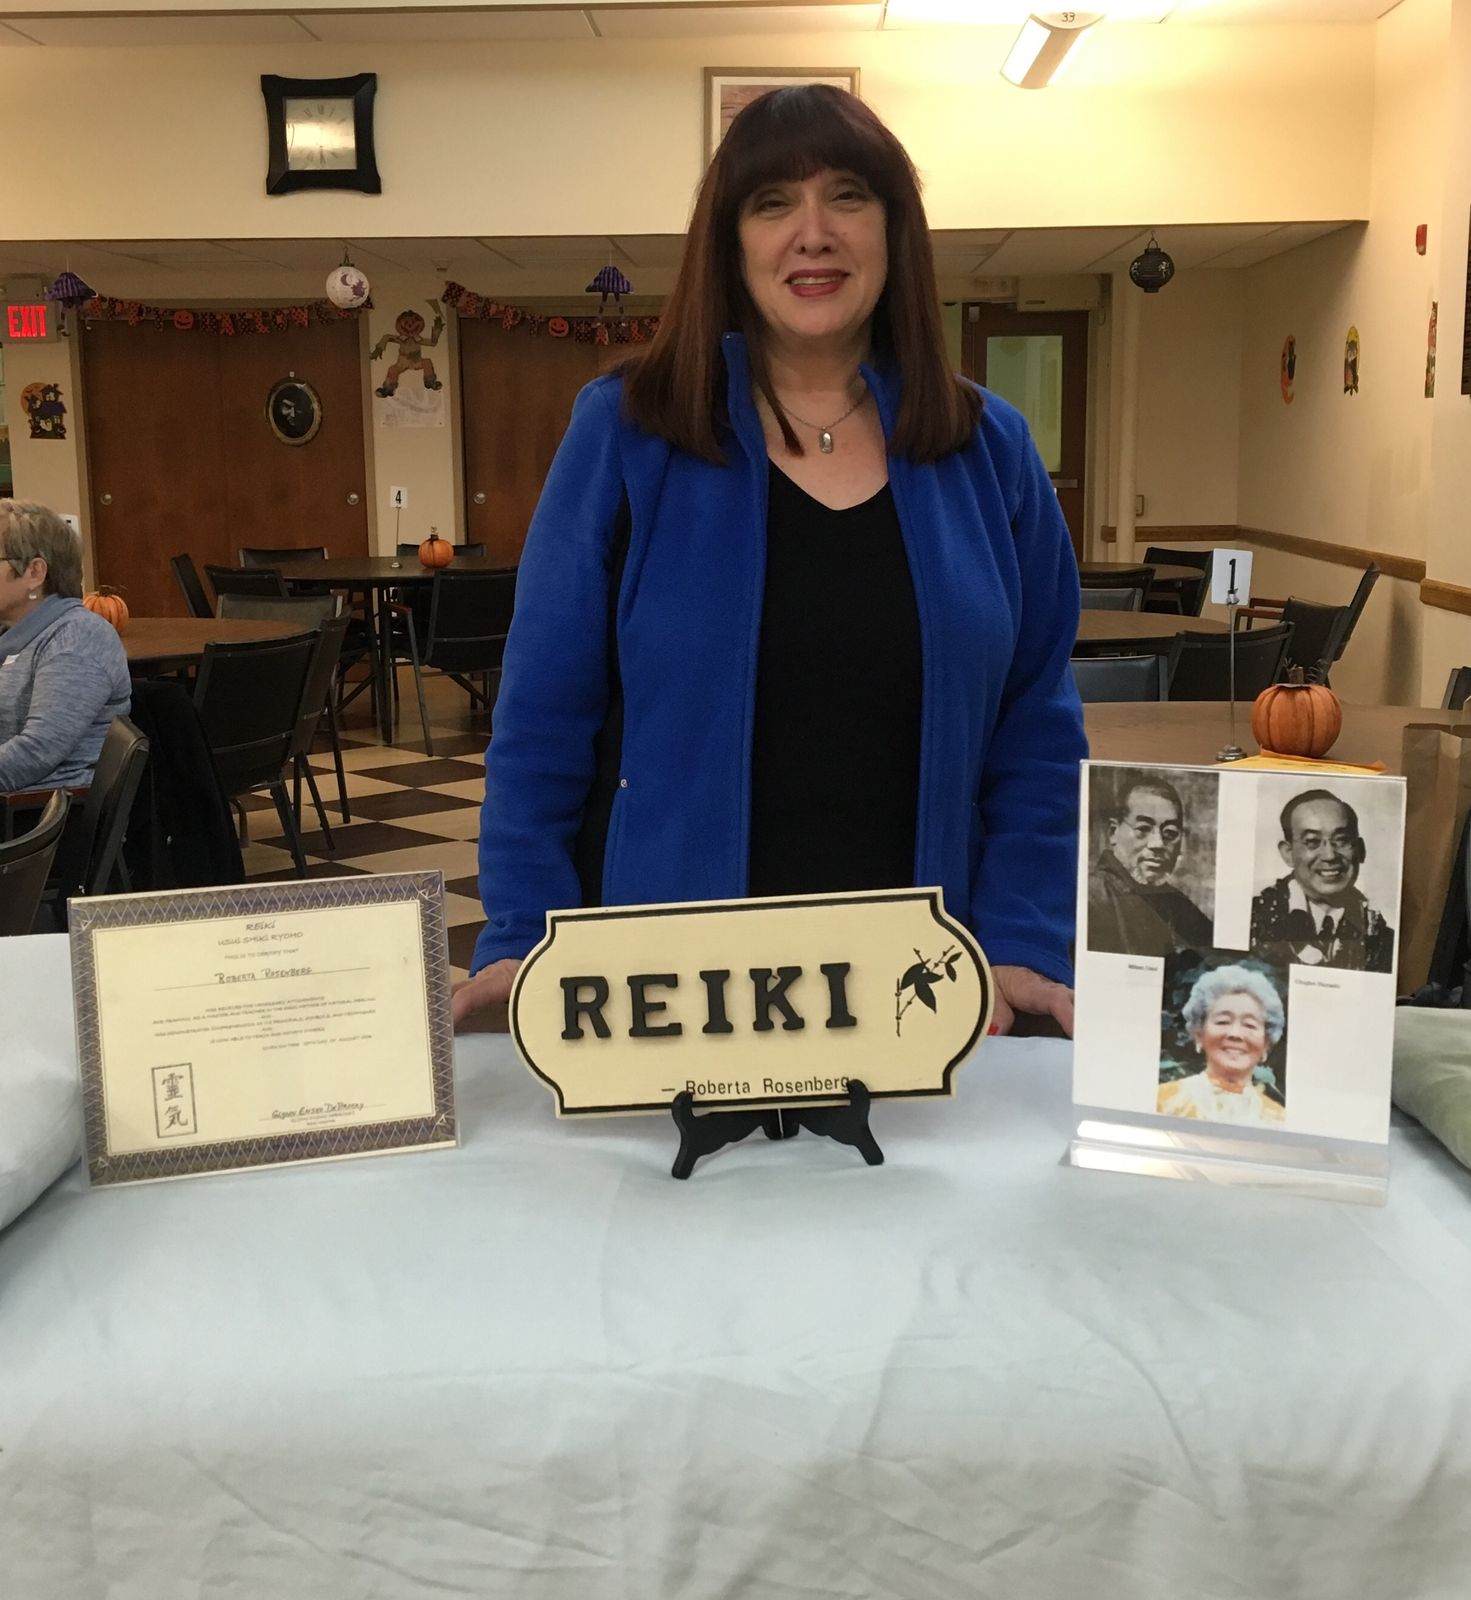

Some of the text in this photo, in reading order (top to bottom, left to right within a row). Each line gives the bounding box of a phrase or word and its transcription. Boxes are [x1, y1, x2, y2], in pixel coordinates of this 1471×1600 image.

[1061, 11, 1076, 23] 33
[7, 304, 48, 338] EXIT
[395, 489, 402, 505] 4
[1227, 558, 1238, 594] 1
[559, 962, 857, 1040] REIKI
[685, 1079, 751, 1096] Roberta
[762, 1076, 850, 1094] Rosenberg
